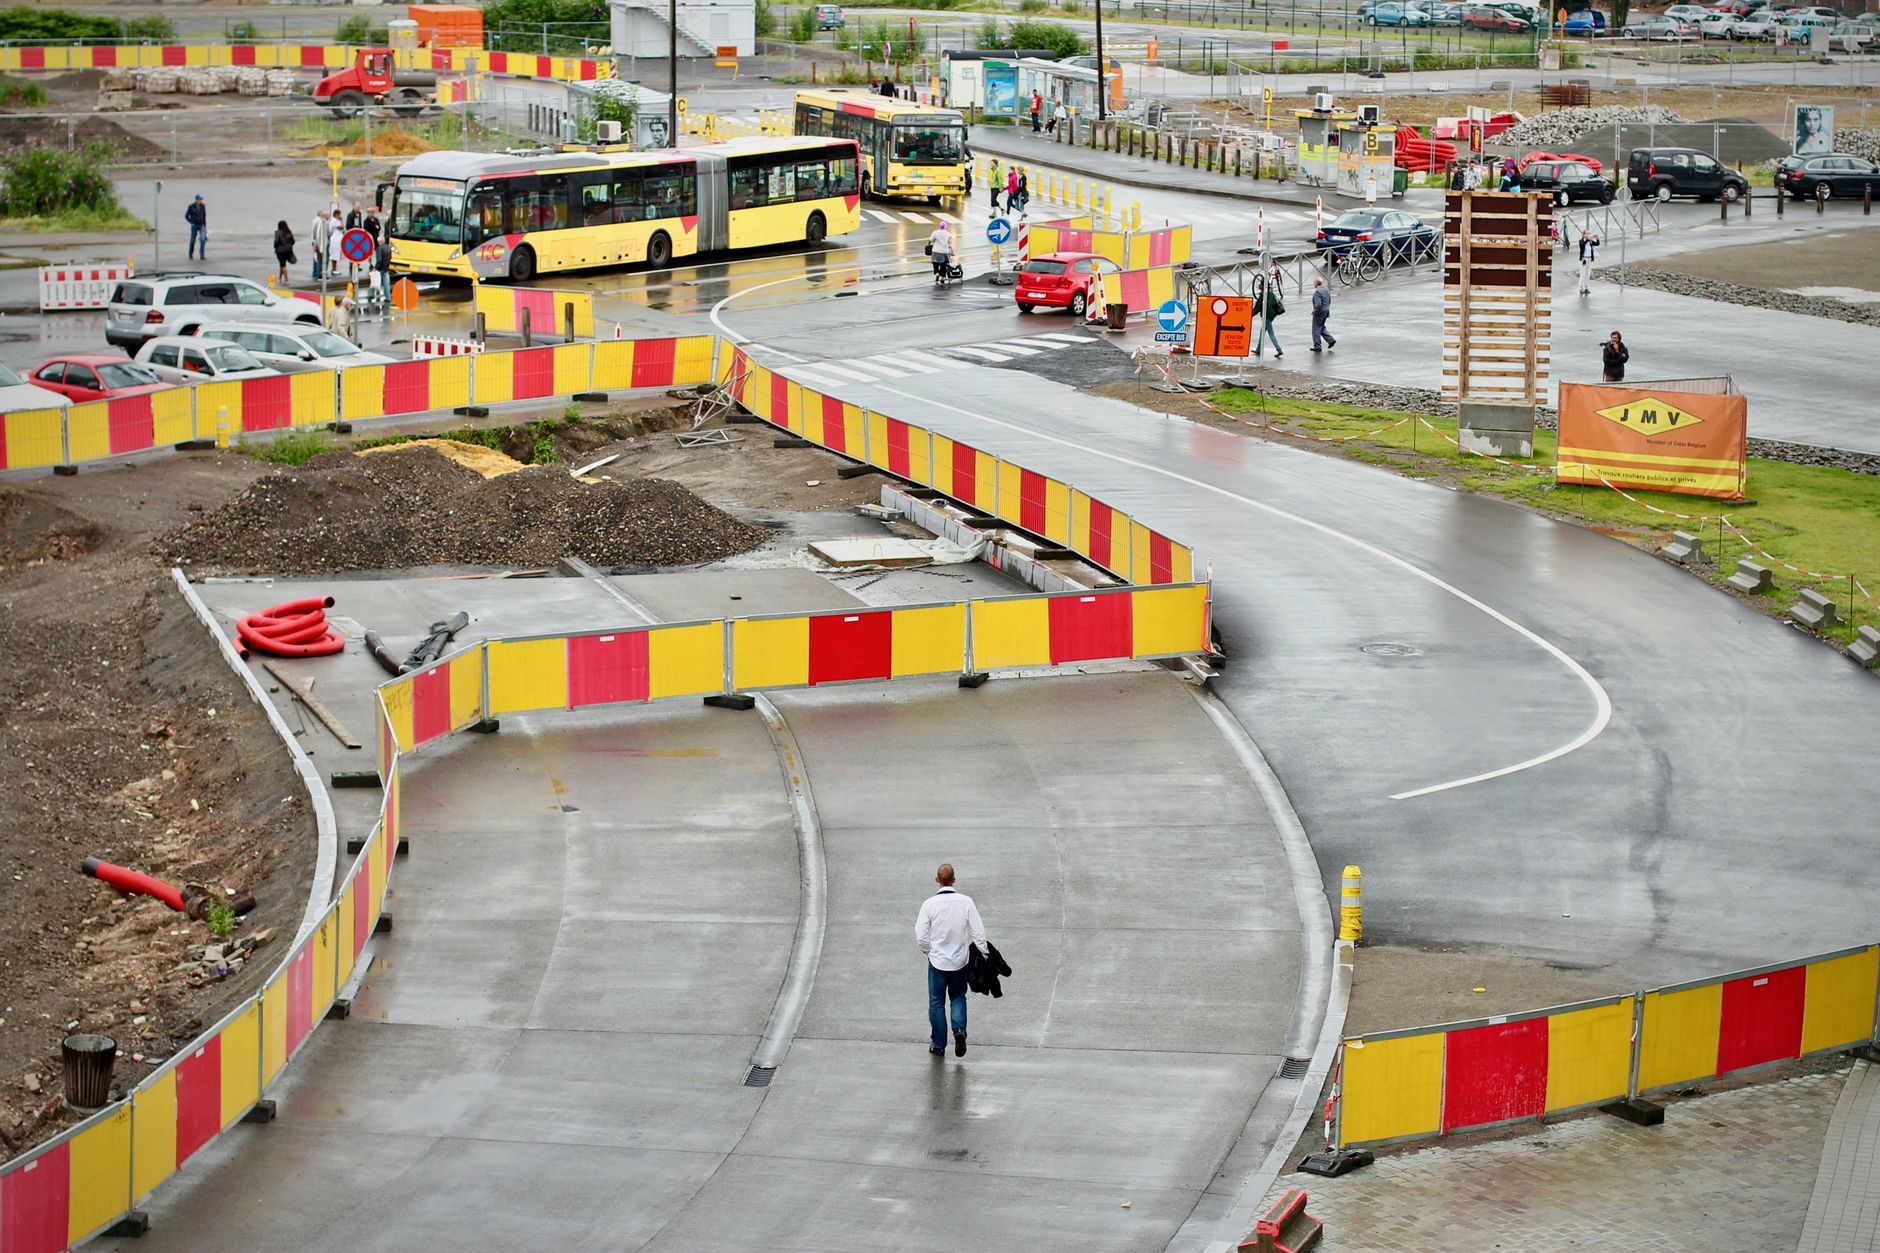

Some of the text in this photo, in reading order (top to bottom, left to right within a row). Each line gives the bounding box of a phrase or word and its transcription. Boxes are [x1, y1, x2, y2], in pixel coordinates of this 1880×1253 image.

[1264, 88, 1271, 101] D
[677, 99, 686, 112] C
[705, 115, 711, 131] A
[1367, 133, 1377, 148] B
[480, 243, 505, 261] TEC
[1156, 333, 1186, 341] EXCEPTE BUS
[1687, 441, 1707, 449] Belgium
[1597, 468, 1621, 477] Travaux
[1622, 472, 1646, 480] routiers
[1646, 474, 1668, 482] publics
[1677, 475, 1697, 484] privés
